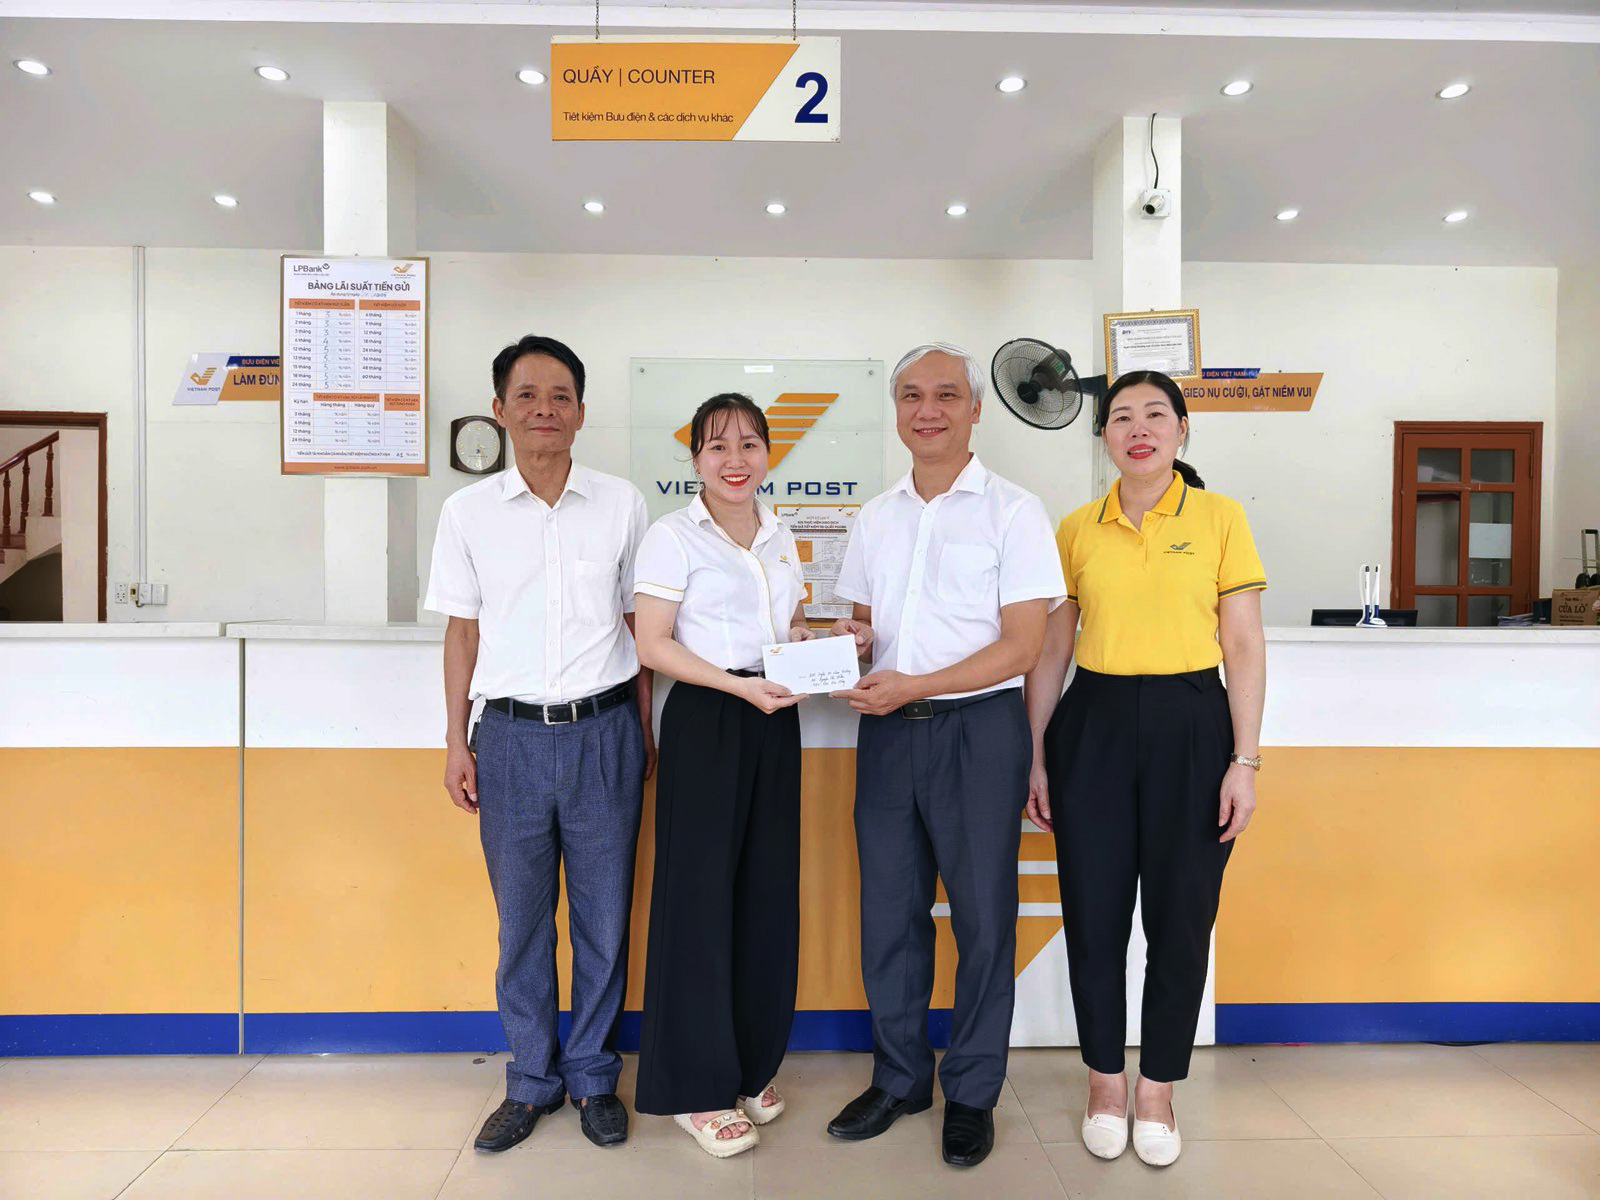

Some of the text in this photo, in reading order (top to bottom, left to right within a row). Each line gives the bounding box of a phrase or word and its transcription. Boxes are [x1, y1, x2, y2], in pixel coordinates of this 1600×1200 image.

[628, 69, 715, 84] COUNTER
[794, 72, 829, 123] 2
[627, 112, 646, 123] điện
[649, 113, 656, 122] &
[657, 112, 674, 122] các
[677, 112, 696, 123] dịch
[698, 114, 709, 123] vụ
[711, 112, 734, 123] khác
[293, 264, 323, 272] LPBank
[308, 280, 334, 290] BẢNG
[335, 280, 349, 290] LÃI
[350, 280, 374, 291] SUẤT
[233, 373, 256, 385] LÀM
[1184, 387, 1205, 398] GIEO
[1297, 387, 1312, 397] VUI
[656, 481, 858, 496] VIEM POST
